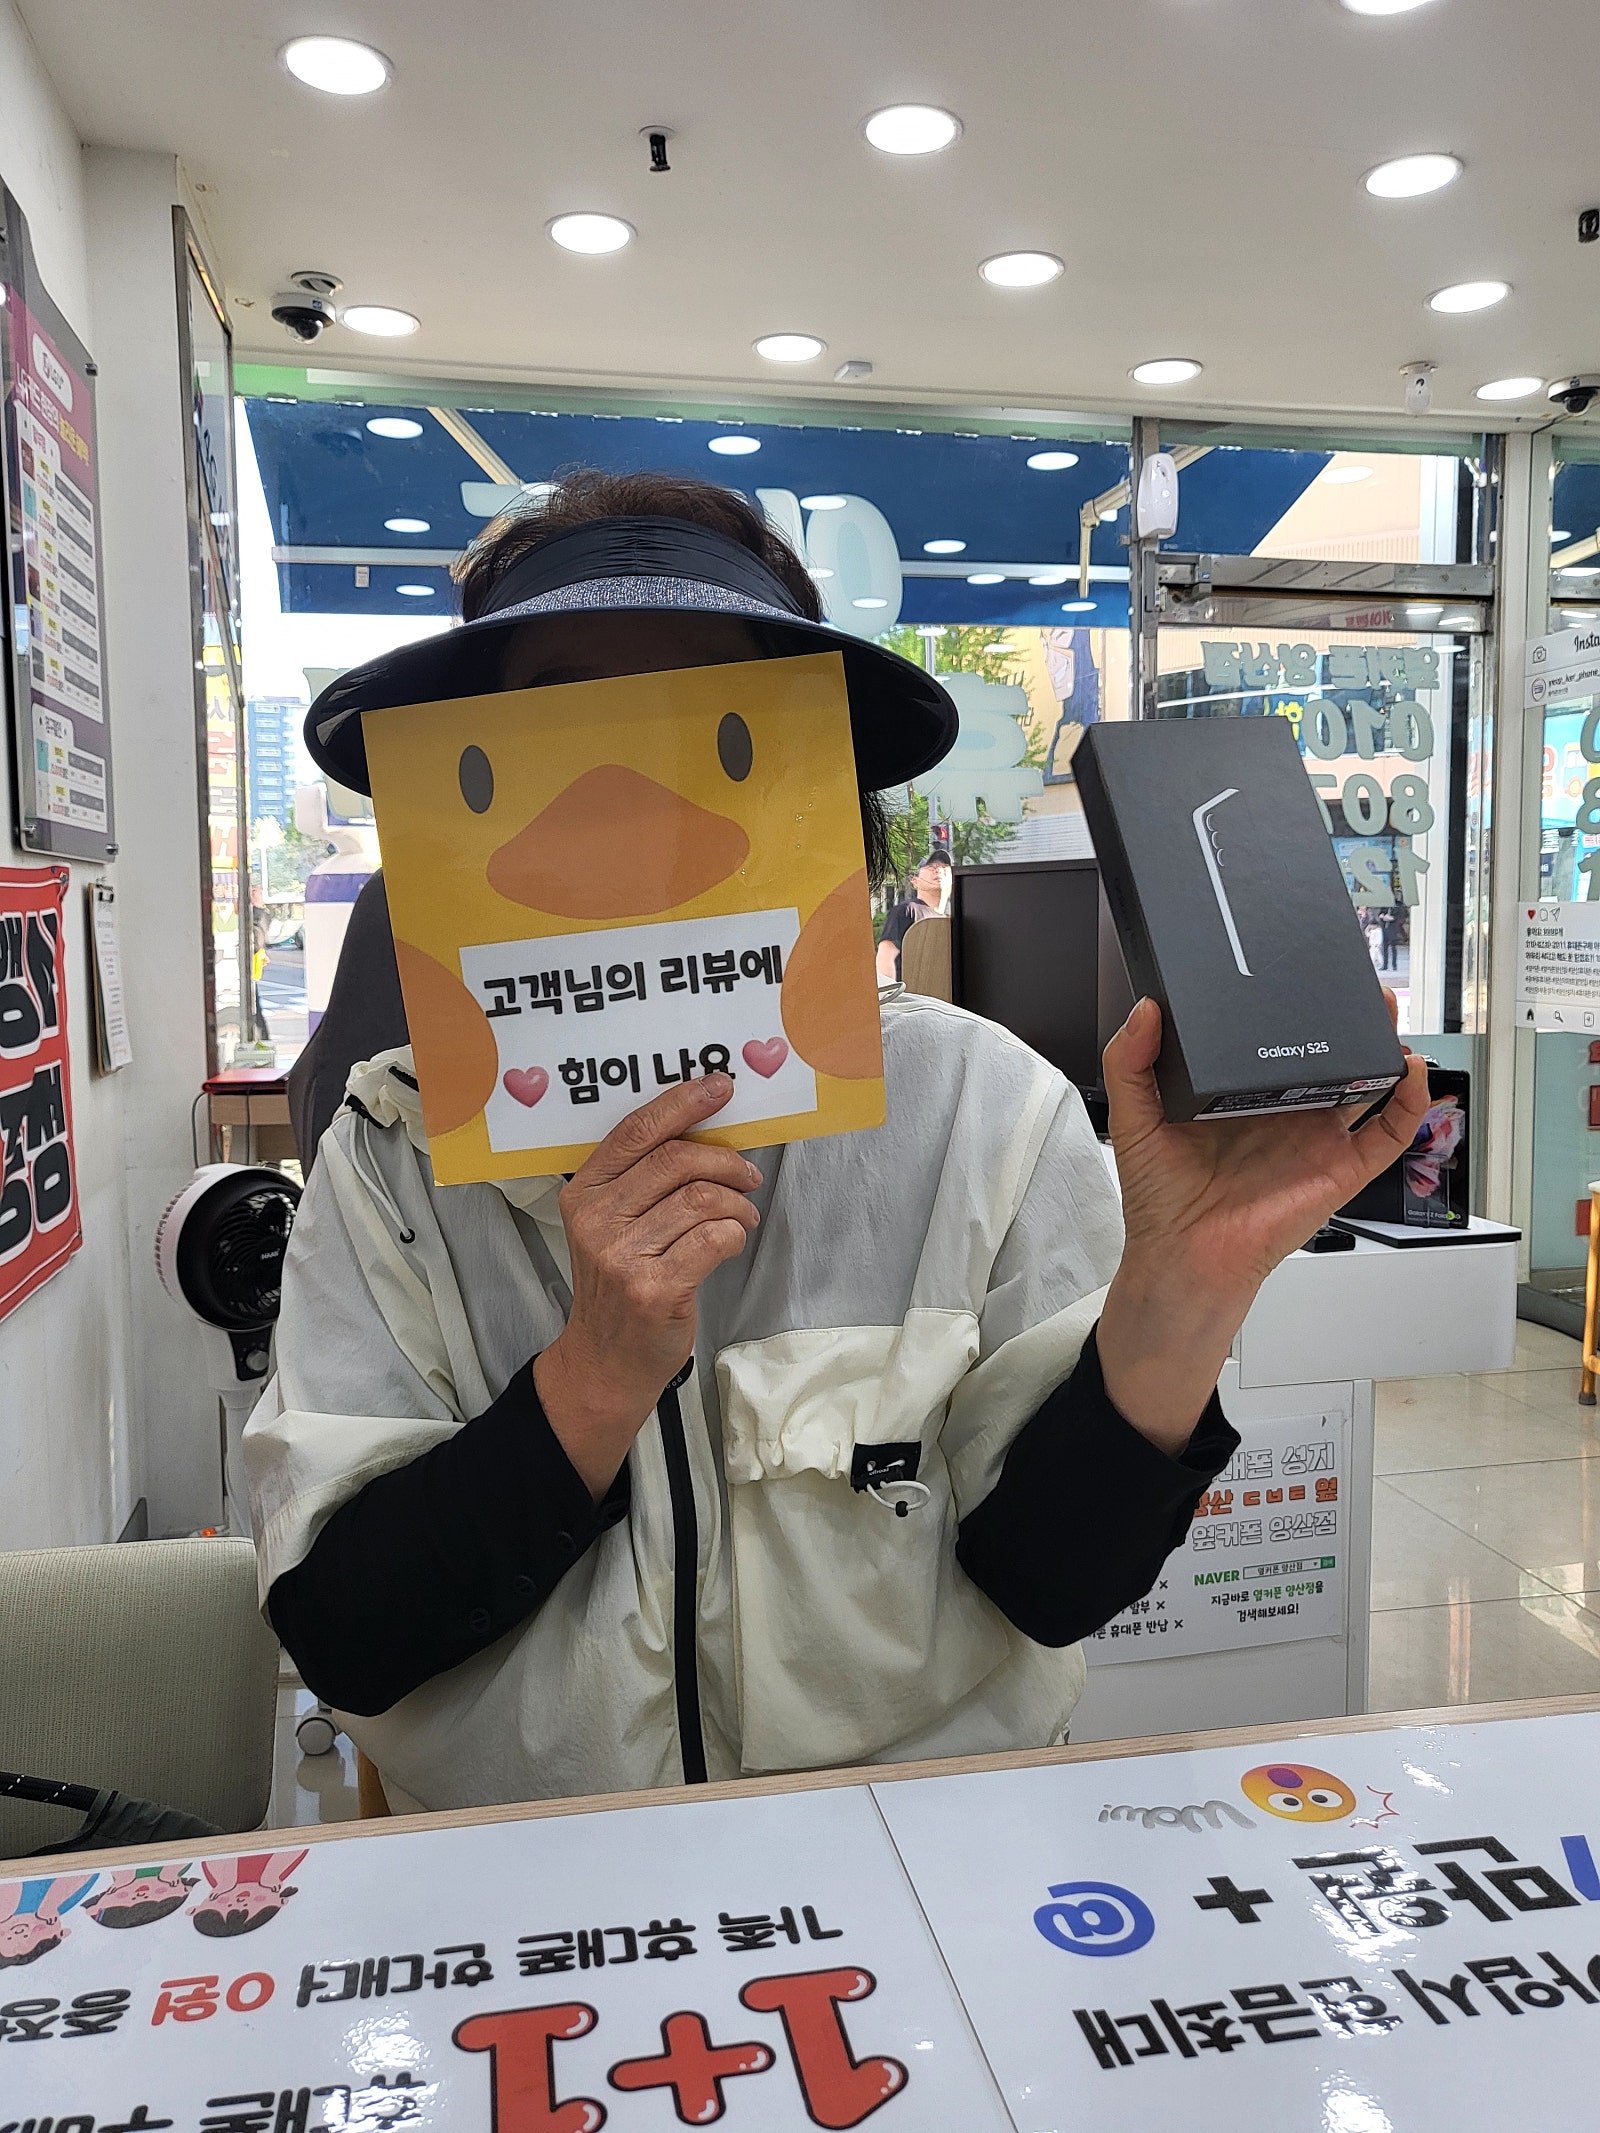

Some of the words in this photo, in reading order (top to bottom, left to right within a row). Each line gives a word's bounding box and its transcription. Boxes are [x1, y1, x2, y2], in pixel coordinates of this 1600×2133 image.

[483, 960, 647, 1019] 고객님의
[660, 944, 783, 995] 리뷰에
[1257, 1042, 1304, 1059] Galaxy
[1306, 1041, 1330, 1054] S25
[558, 1054, 641, 1106] 힘이
[1212, 1448, 1272, 1482] 대폰
[1281, 1441, 1335, 1476] 성지
[1192, 1518, 1262, 1551] 옆커폰
[1269, 1509, 1337, 1542] 양산점
[1194, 1569, 1241, 1586] NAVER
[1210, 1591, 1250, 1606] 지금바로
[1285, 1580, 1324, 1598] 양산점을
[1110, 1621, 1142, 1638] 휴대폰
[1146, 1619, 1169, 1634] 반납
[1237, 1602, 1299, 1623] 검색해보세요!
[1097, 1799, 1258, 1834] Wow!
[515, 1917, 699, 1977] 휴대폰
[717, 1904, 844, 1953] 가족
[296, 1942, 495, 2008] 한대더
[150, 1970, 276, 2027] 0원
[1072, 1975, 1404, 2070] 현금최대
